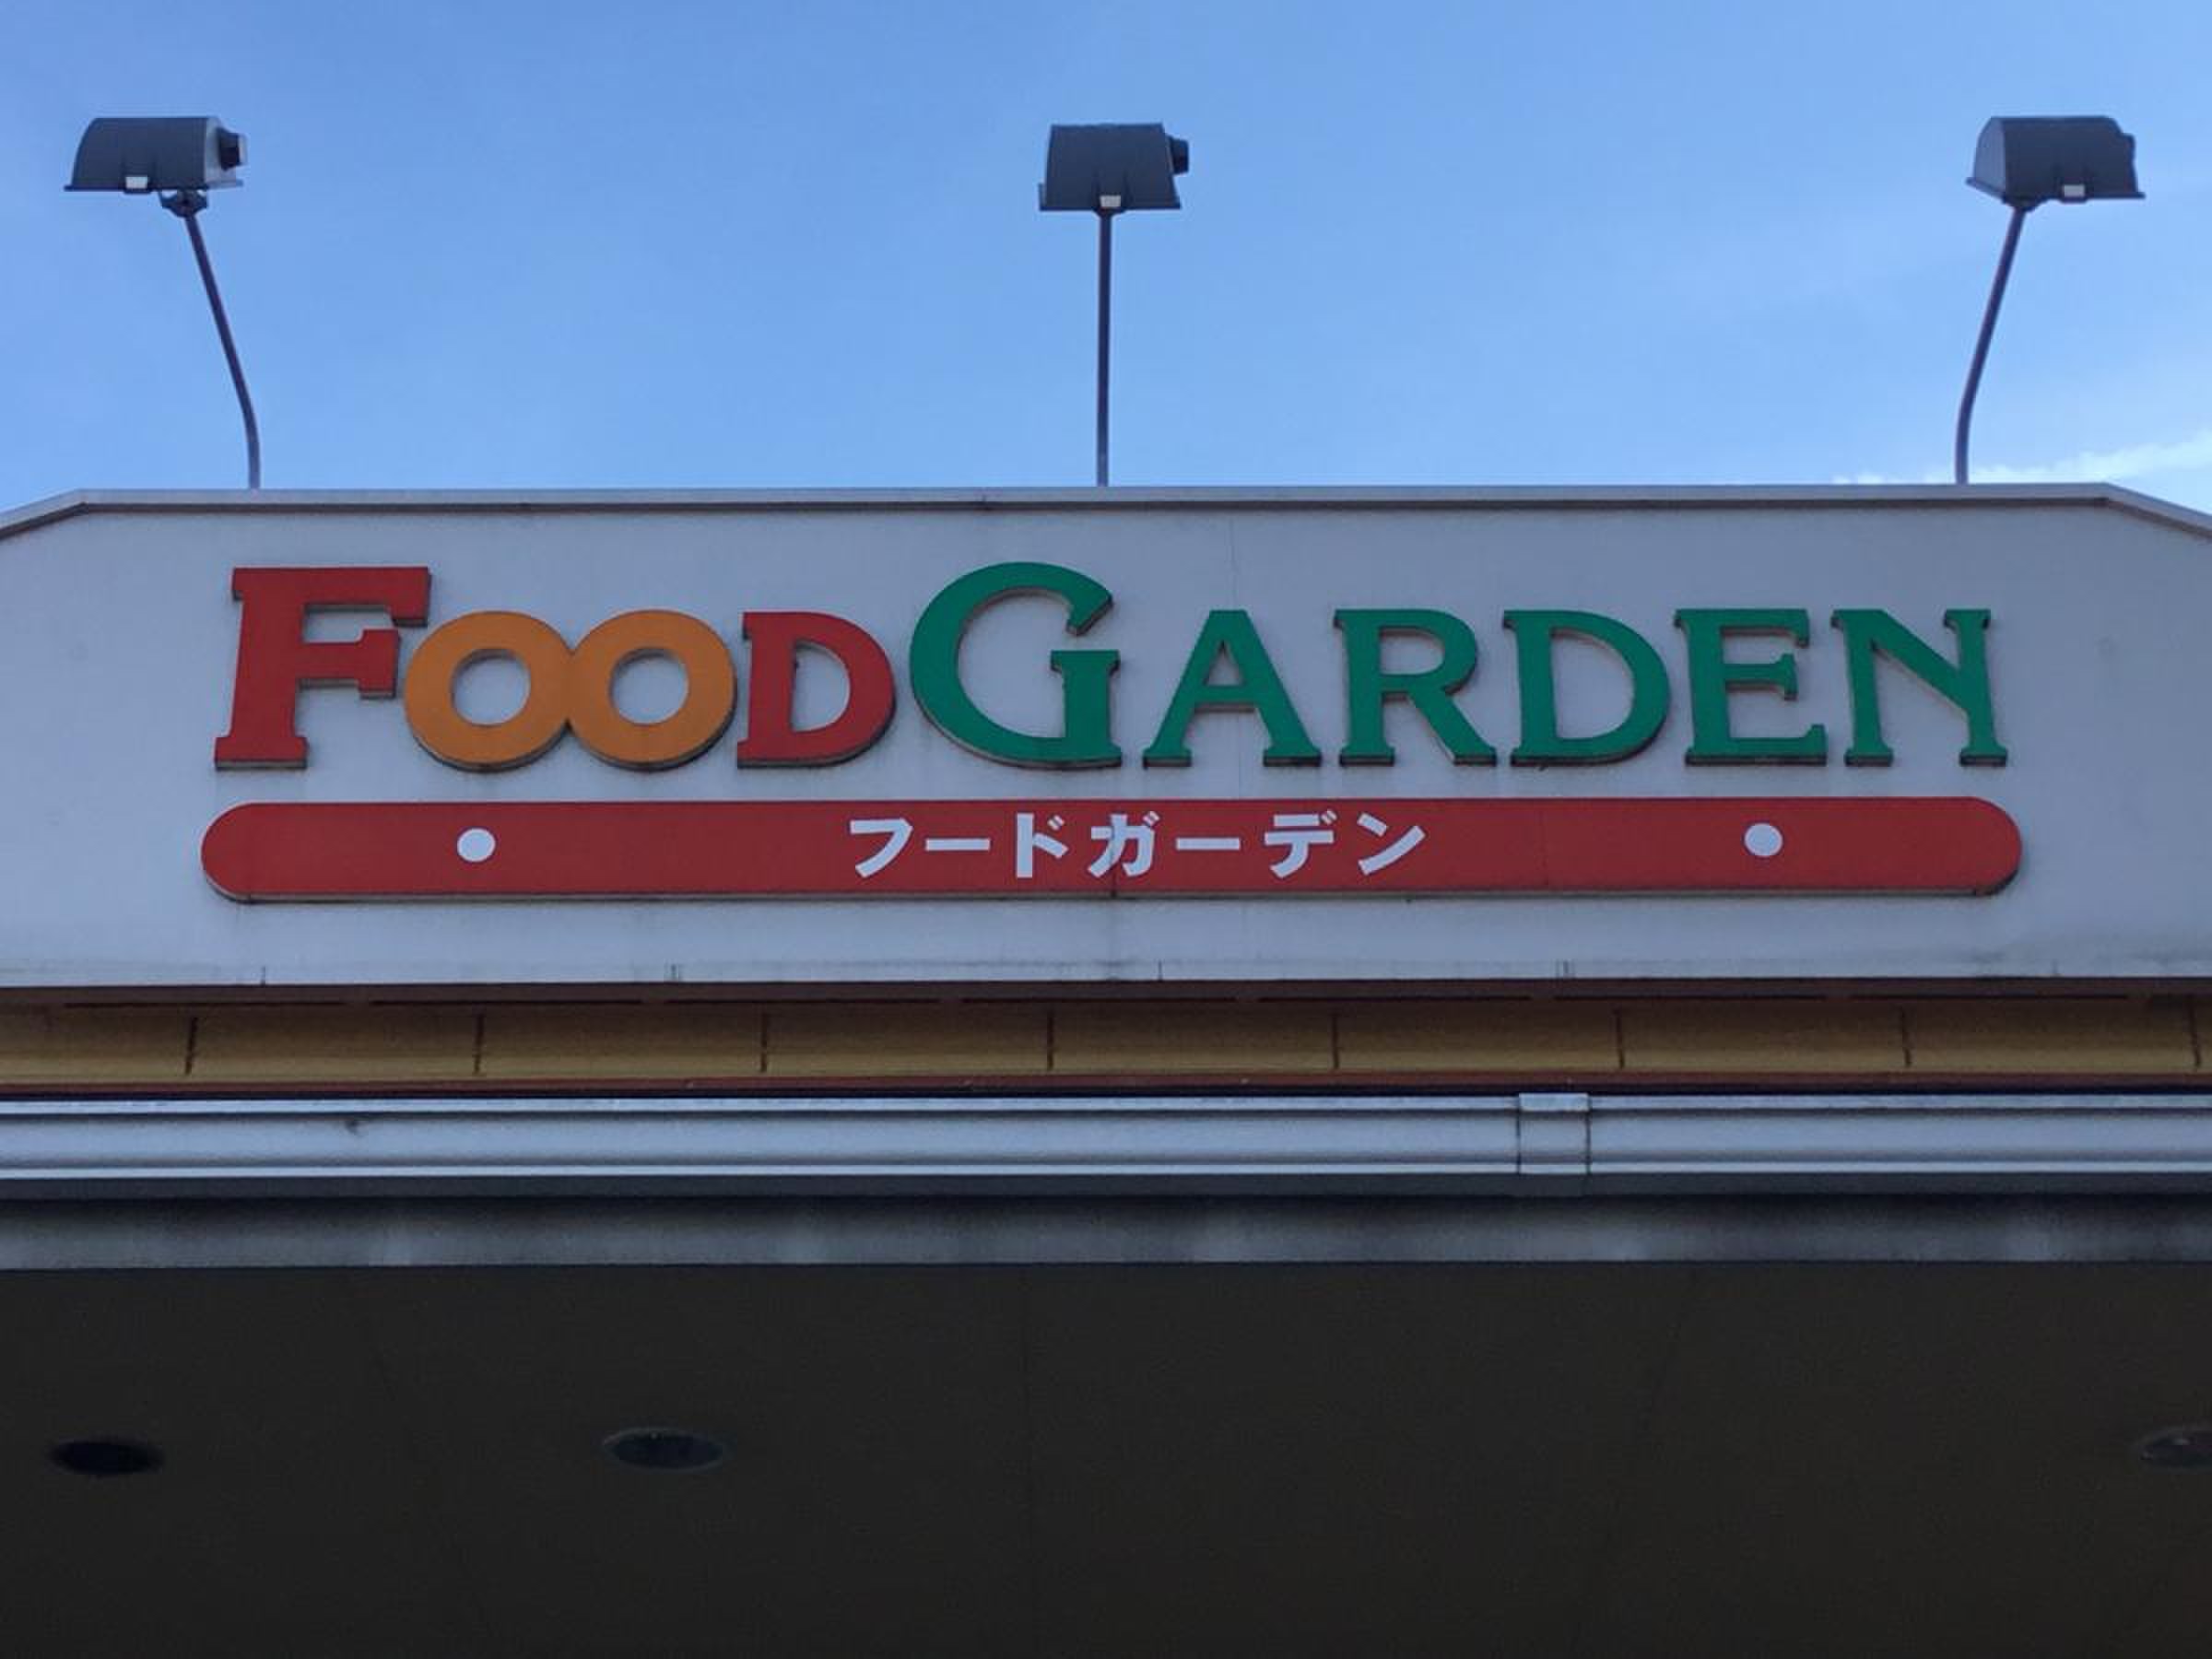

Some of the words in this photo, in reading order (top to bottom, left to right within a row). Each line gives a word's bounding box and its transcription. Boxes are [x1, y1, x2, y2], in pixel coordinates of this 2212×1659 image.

[215, 566, 897, 771] FOOD
[910, 561, 2008, 769] GARDEN
[849, 810, 1426, 879] フードガーデン
